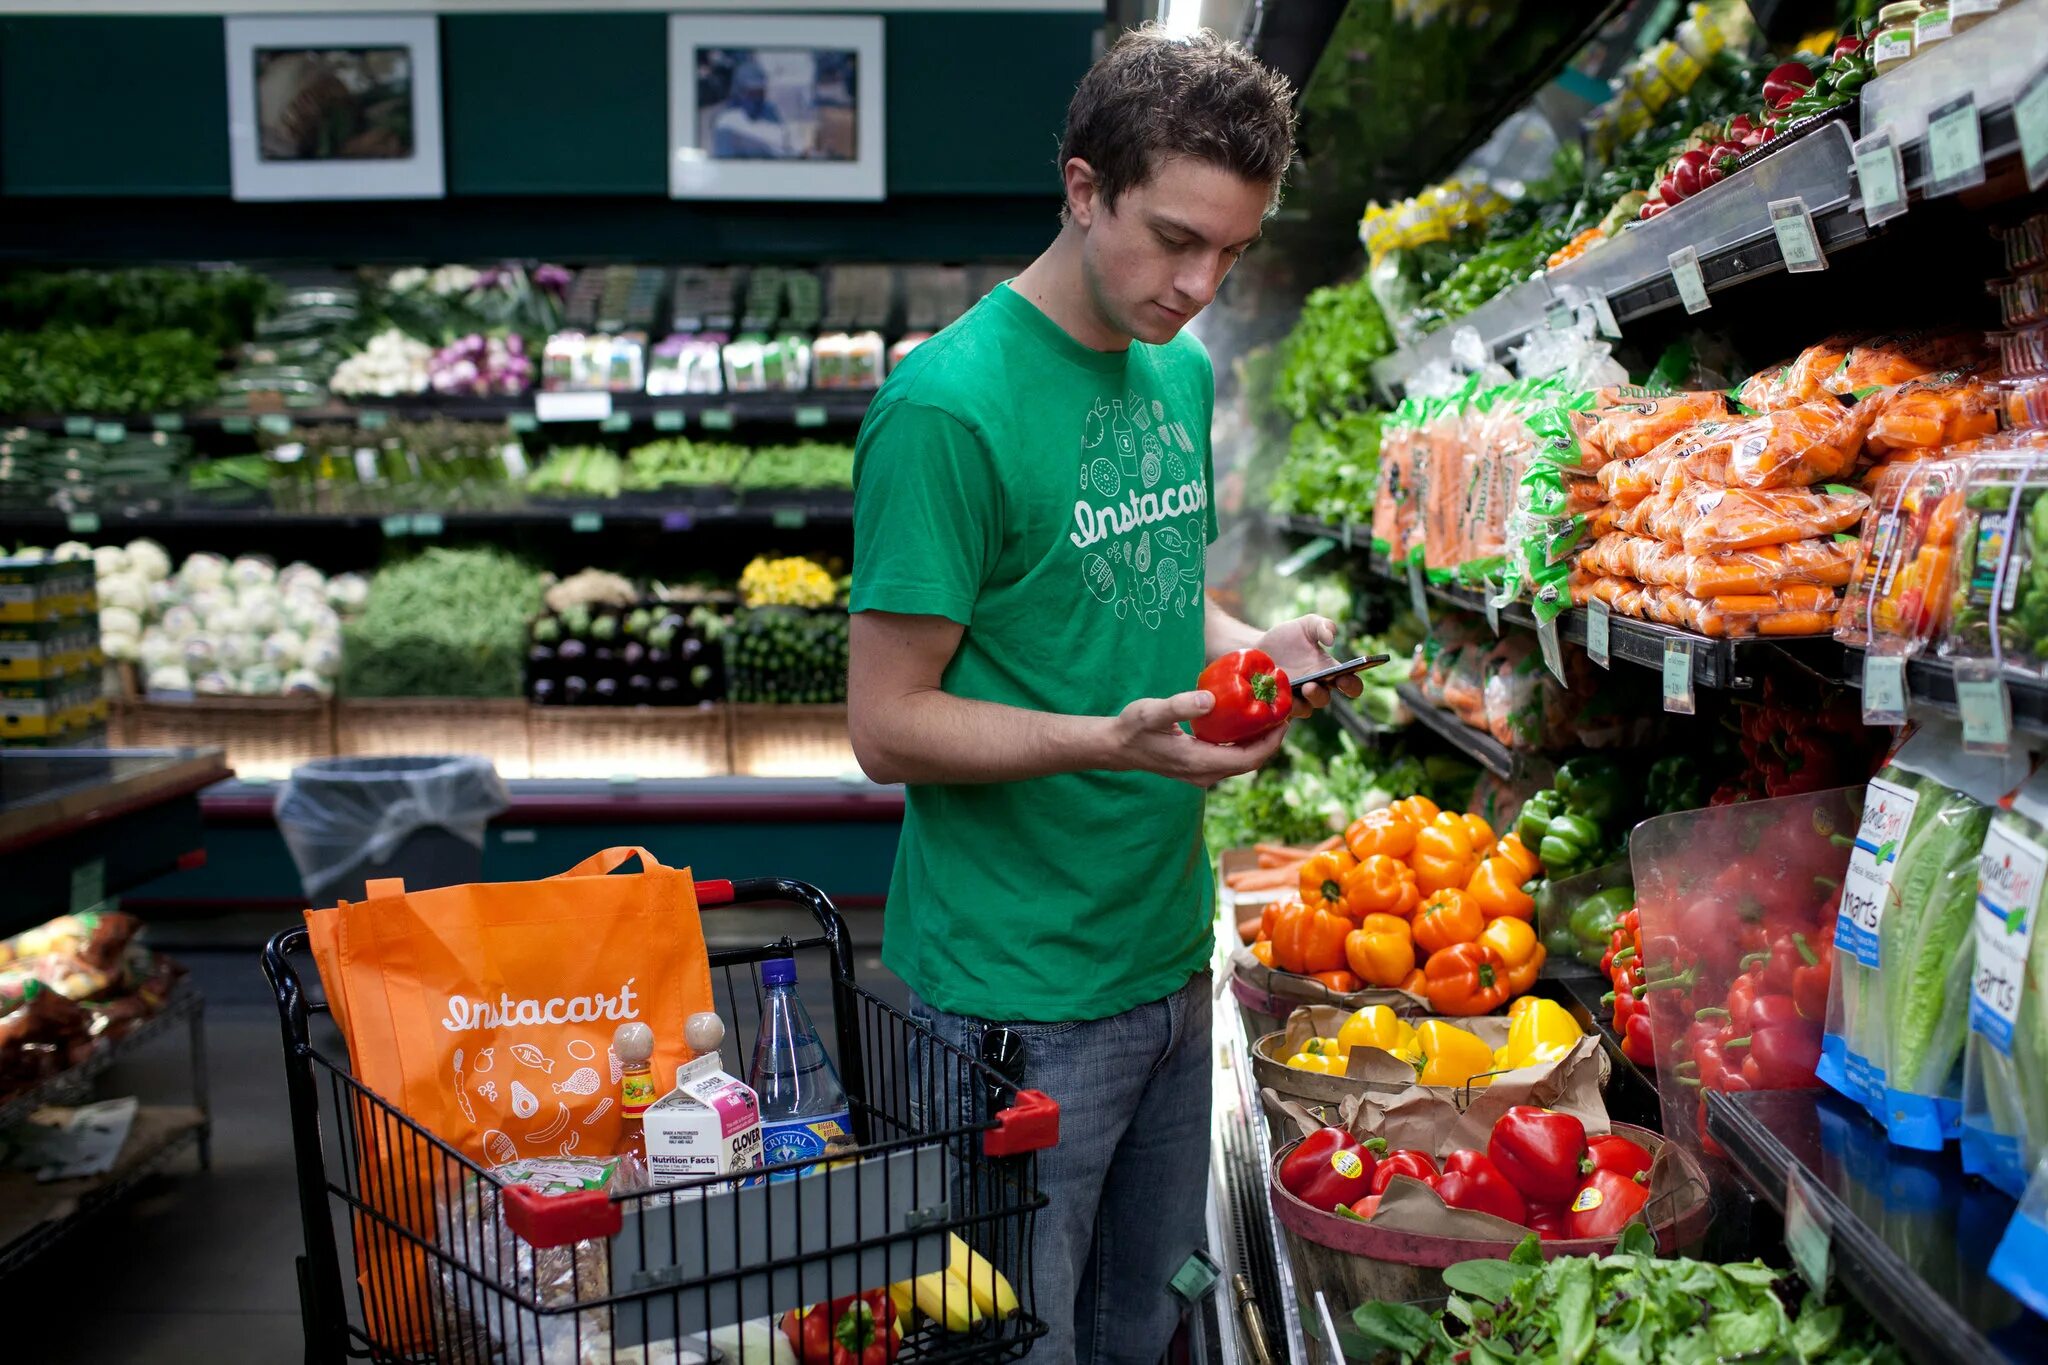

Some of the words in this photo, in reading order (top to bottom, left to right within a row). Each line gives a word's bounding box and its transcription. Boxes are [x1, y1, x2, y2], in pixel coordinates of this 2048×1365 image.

[1070, 480, 1207, 548] Instacar
[441, 977, 640, 1031] Instacart
[733, 1127, 760, 1152] CLOVER
[764, 1134, 807, 1151] CRYSTAL
[652, 1156, 688, 1164] Nutrition
[690, 1156, 715, 1164] Facts
